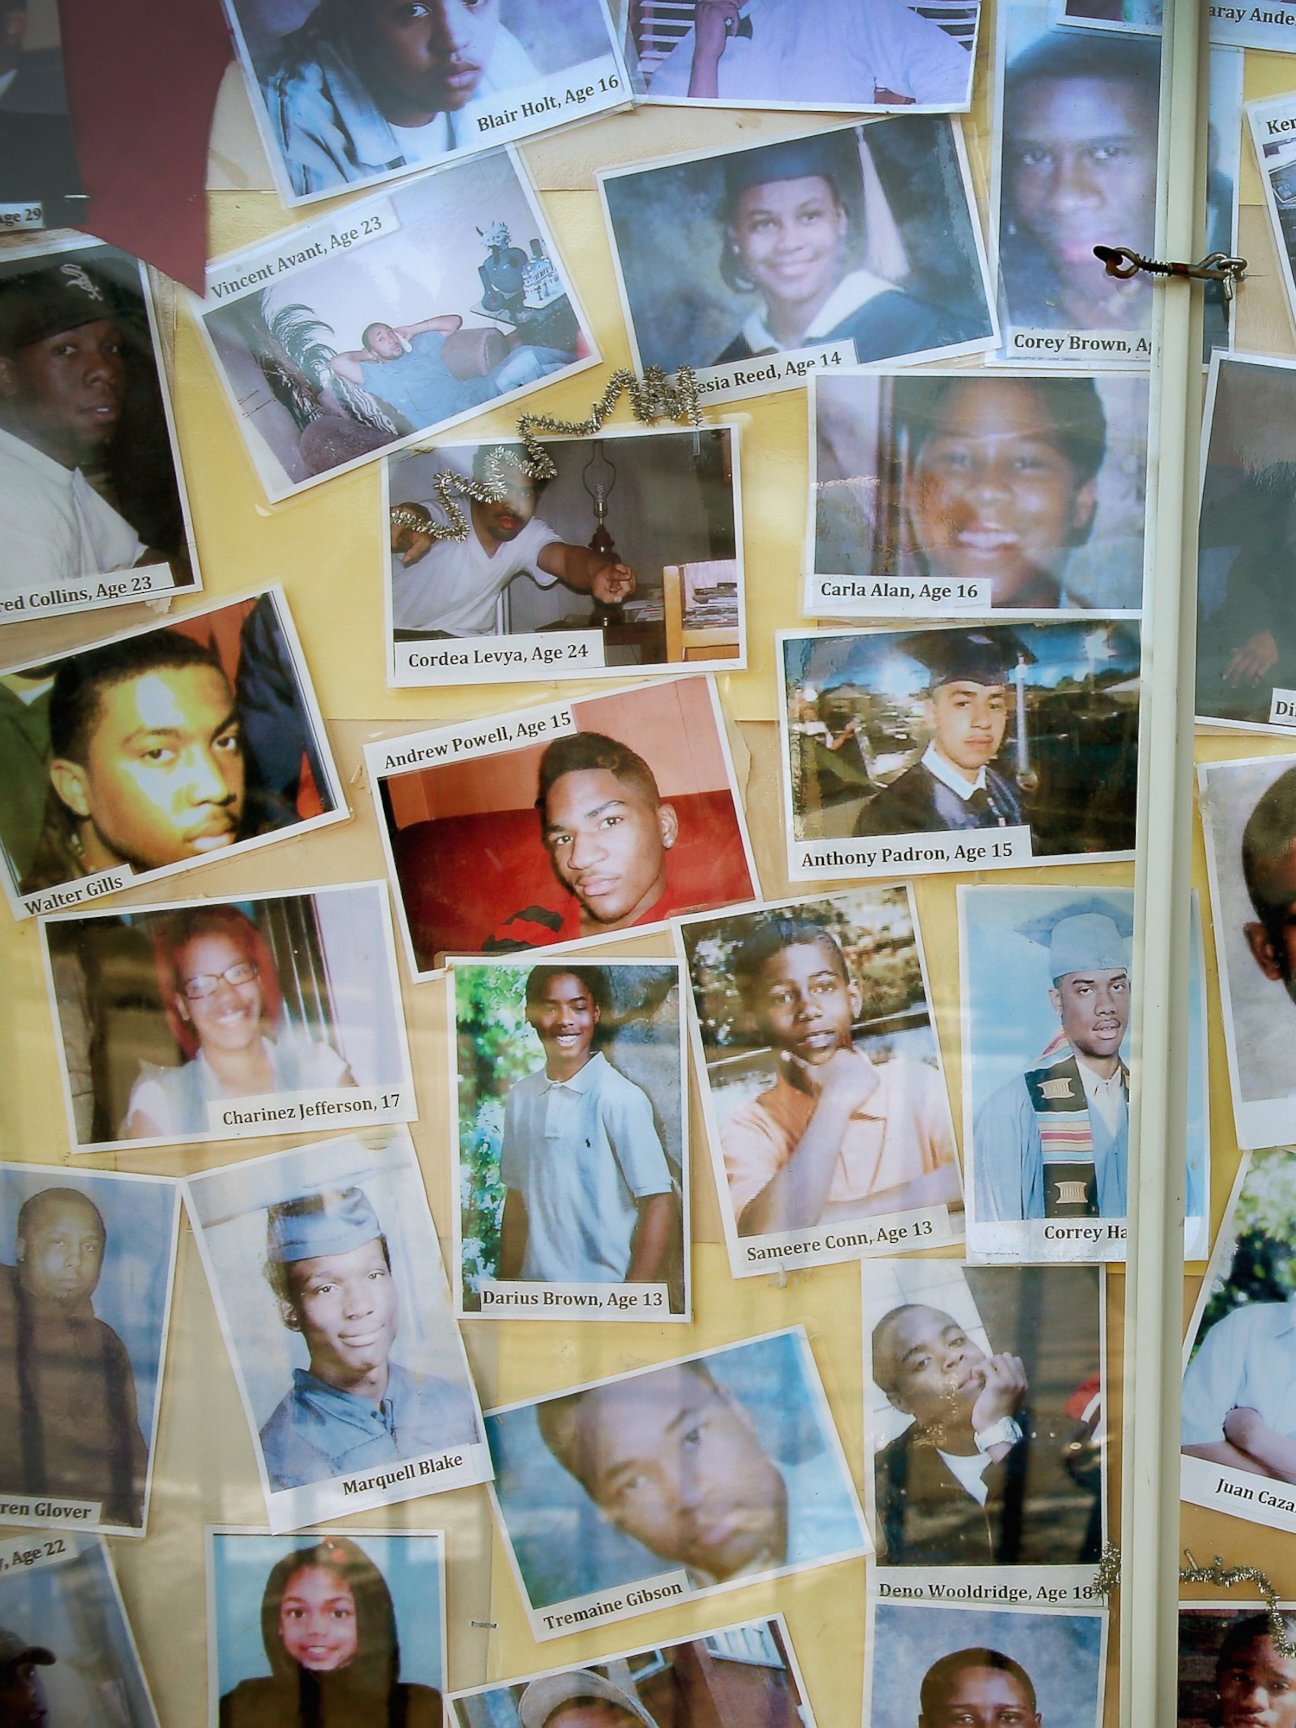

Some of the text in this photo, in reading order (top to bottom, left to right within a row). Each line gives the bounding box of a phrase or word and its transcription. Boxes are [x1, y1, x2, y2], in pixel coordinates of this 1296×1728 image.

[476, 74, 618, 131] Blair Holt, Age 16
[0, 206, 41, 226] ge 29
[211, 216, 381, 298] Vincent Avant, Age 23
[1014, 334, 1064, 352] Corey
[1068, 335, 1131, 353] Brown,
[733, 364, 781, 386] Reed,
[819, 351, 841, 365] 14
[29, 589, 92, 607] Collins,
[95, 583, 128, 600] Age
[130, 575, 151, 591] 23
[821, 582, 977, 601] Carla Alan, Age 16
[408, 643, 588, 667] Cordea Levya, Age 24
[384, 711, 570, 769] Andrew Powell, Age 15
[801, 842, 1012, 867] Anthony Padron, Age 15
[23, 876, 123, 914] Walter Gills
[222, 1093, 399, 1125] Charinez Jefferson, 17
[747, 1220, 932, 1260] Sameere Conn, Age 13
[1044, 1225, 1102, 1242] Correy
[482, 1290, 662, 1309] Darius Brown, Age 13
[343, 1455, 462, 1495] Marquell Blake
[1215, 1478, 1253, 1500] Juan
[34, 1502, 91, 1518] Glover
[12, 1548, 42, 1565] Age
[43, 1539, 66, 1556] 22
[542, 1583, 682, 1629] Tremaine Gibson
[879, 1583, 1092, 1603] Deno Wooldridge, Age 18
